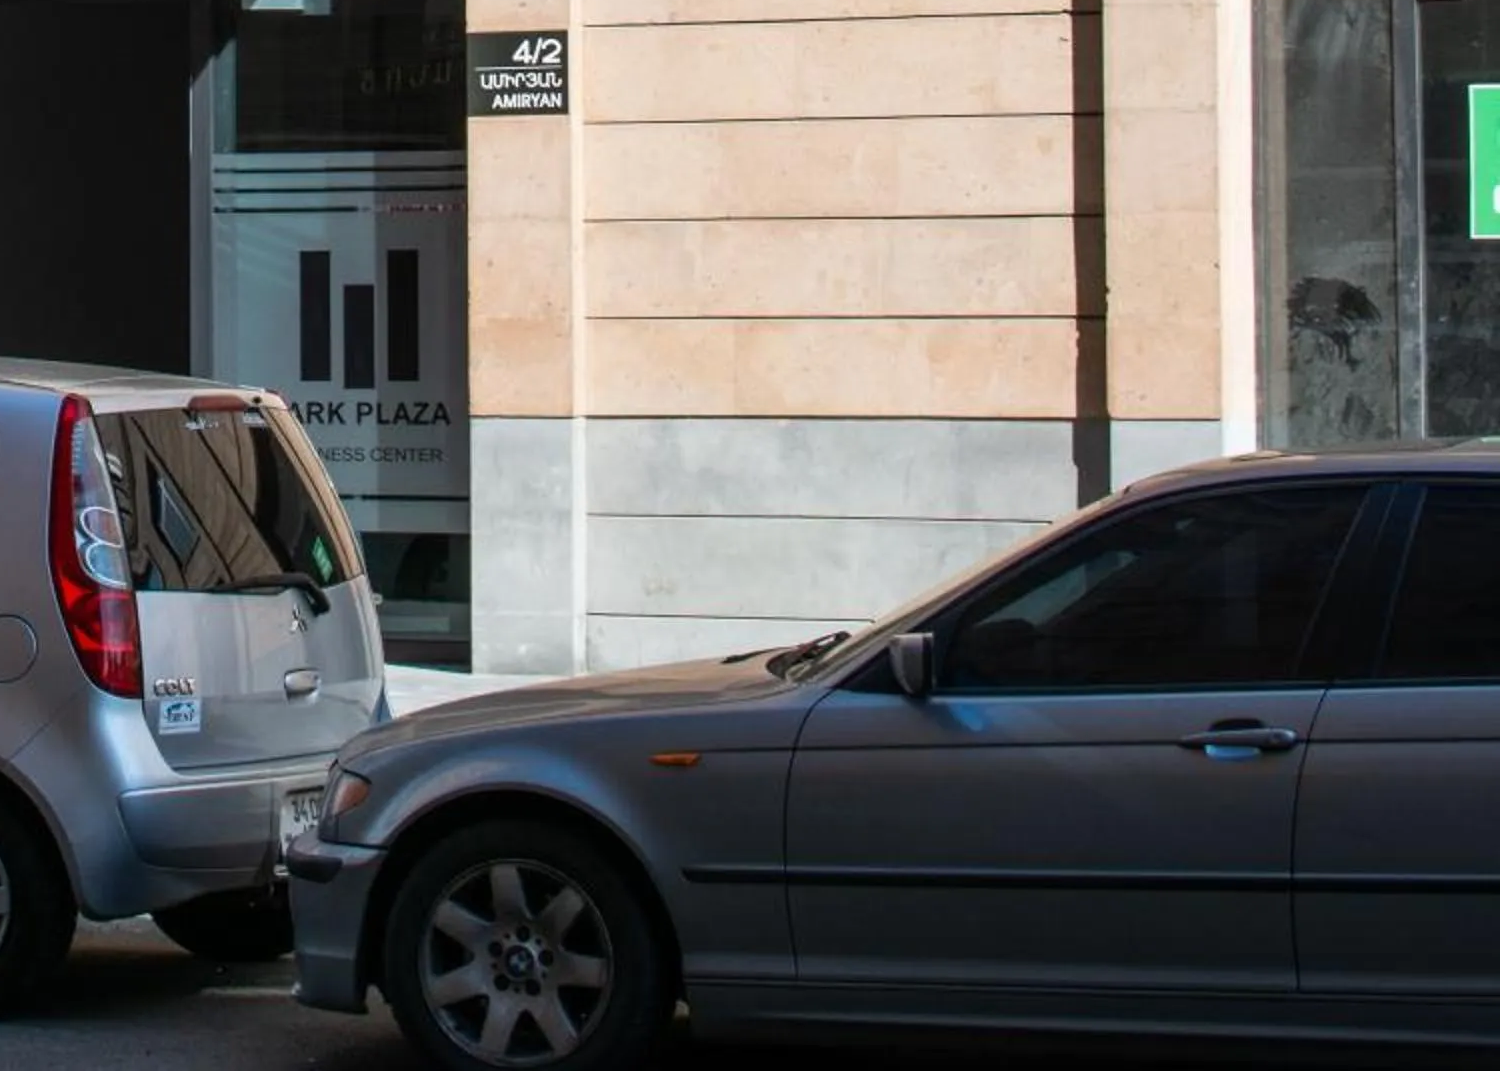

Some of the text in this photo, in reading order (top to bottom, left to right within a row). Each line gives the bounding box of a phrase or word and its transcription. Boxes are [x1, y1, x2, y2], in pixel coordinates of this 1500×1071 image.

[512, 37, 563, 64] 4/2
[480, 71, 563, 90] ԱՄԻՐՅԱՆ
[491, 91, 563, 110] AMIRYAN
[289, 401, 451, 427] ARK PLAZA
[369, 446, 444, 463] CENTER
